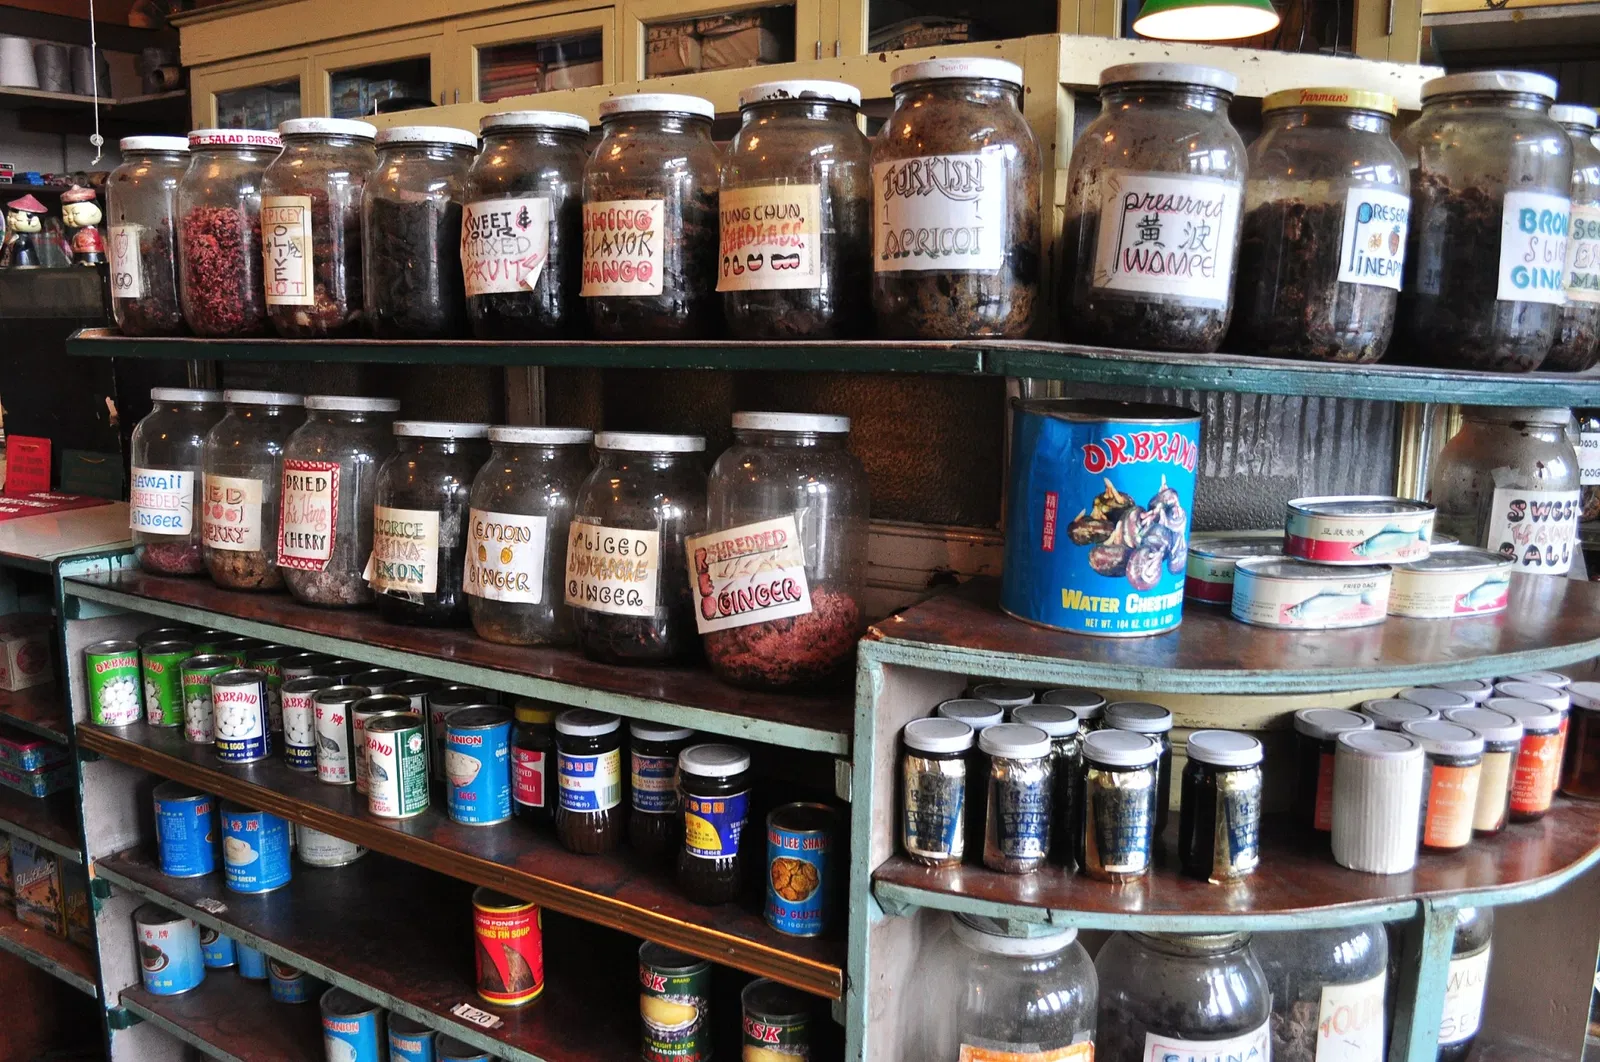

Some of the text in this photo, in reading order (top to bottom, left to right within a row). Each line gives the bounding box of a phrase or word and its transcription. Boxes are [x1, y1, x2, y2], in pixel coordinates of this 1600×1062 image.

[209, 134, 244, 144] SALAD
[883, 157, 985, 200] TURKISH
[882, 227, 985, 259] APRICOT
[274, 225, 288, 281] OLIVE
[286, 475, 328, 492] DRIED
[285, 531, 327, 550] CHERRY
[707, 529, 787, 562] SHREDDED
[718, 577, 801, 617] GINGER
[1085, 618, 1098, 628] NET
[230, 742, 245, 751] EGGS
[297, 749, 312, 757] EGGS
[784, 837, 800, 850] LEE
[498, 930, 510, 939] FIN
[511, 926, 530, 939] SOUP
[650, 1046, 687, 1056] SEASONED
[652, 1041, 672, 1050] WEIGHT
